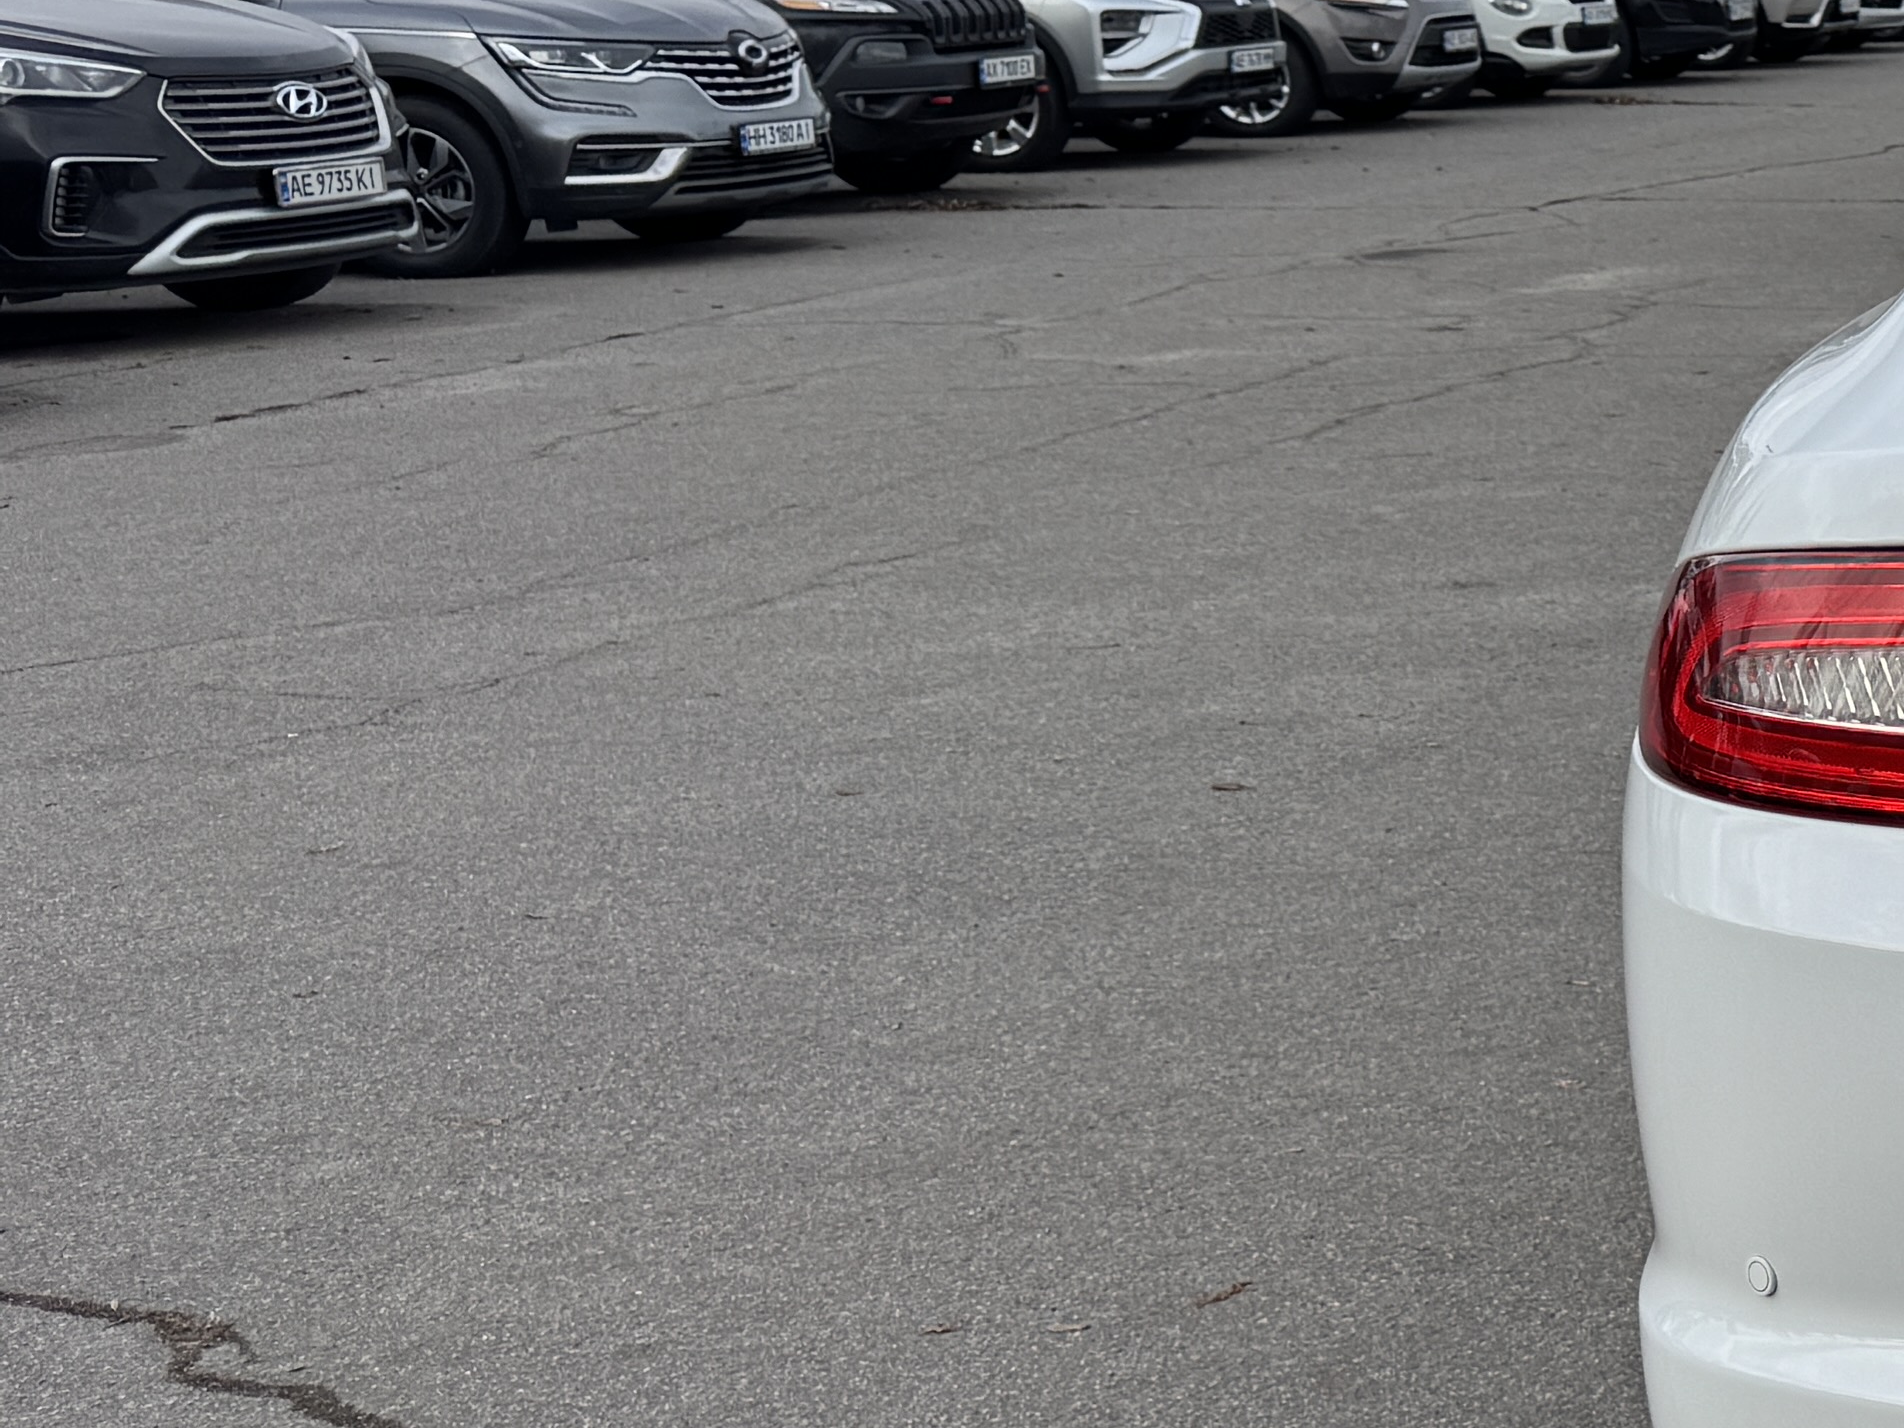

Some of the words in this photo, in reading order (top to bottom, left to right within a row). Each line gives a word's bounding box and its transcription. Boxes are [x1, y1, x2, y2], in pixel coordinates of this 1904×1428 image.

[291, 174, 315, 199] AE
[316, 169, 354, 195] 9735
[355, 166, 376, 191] KI
